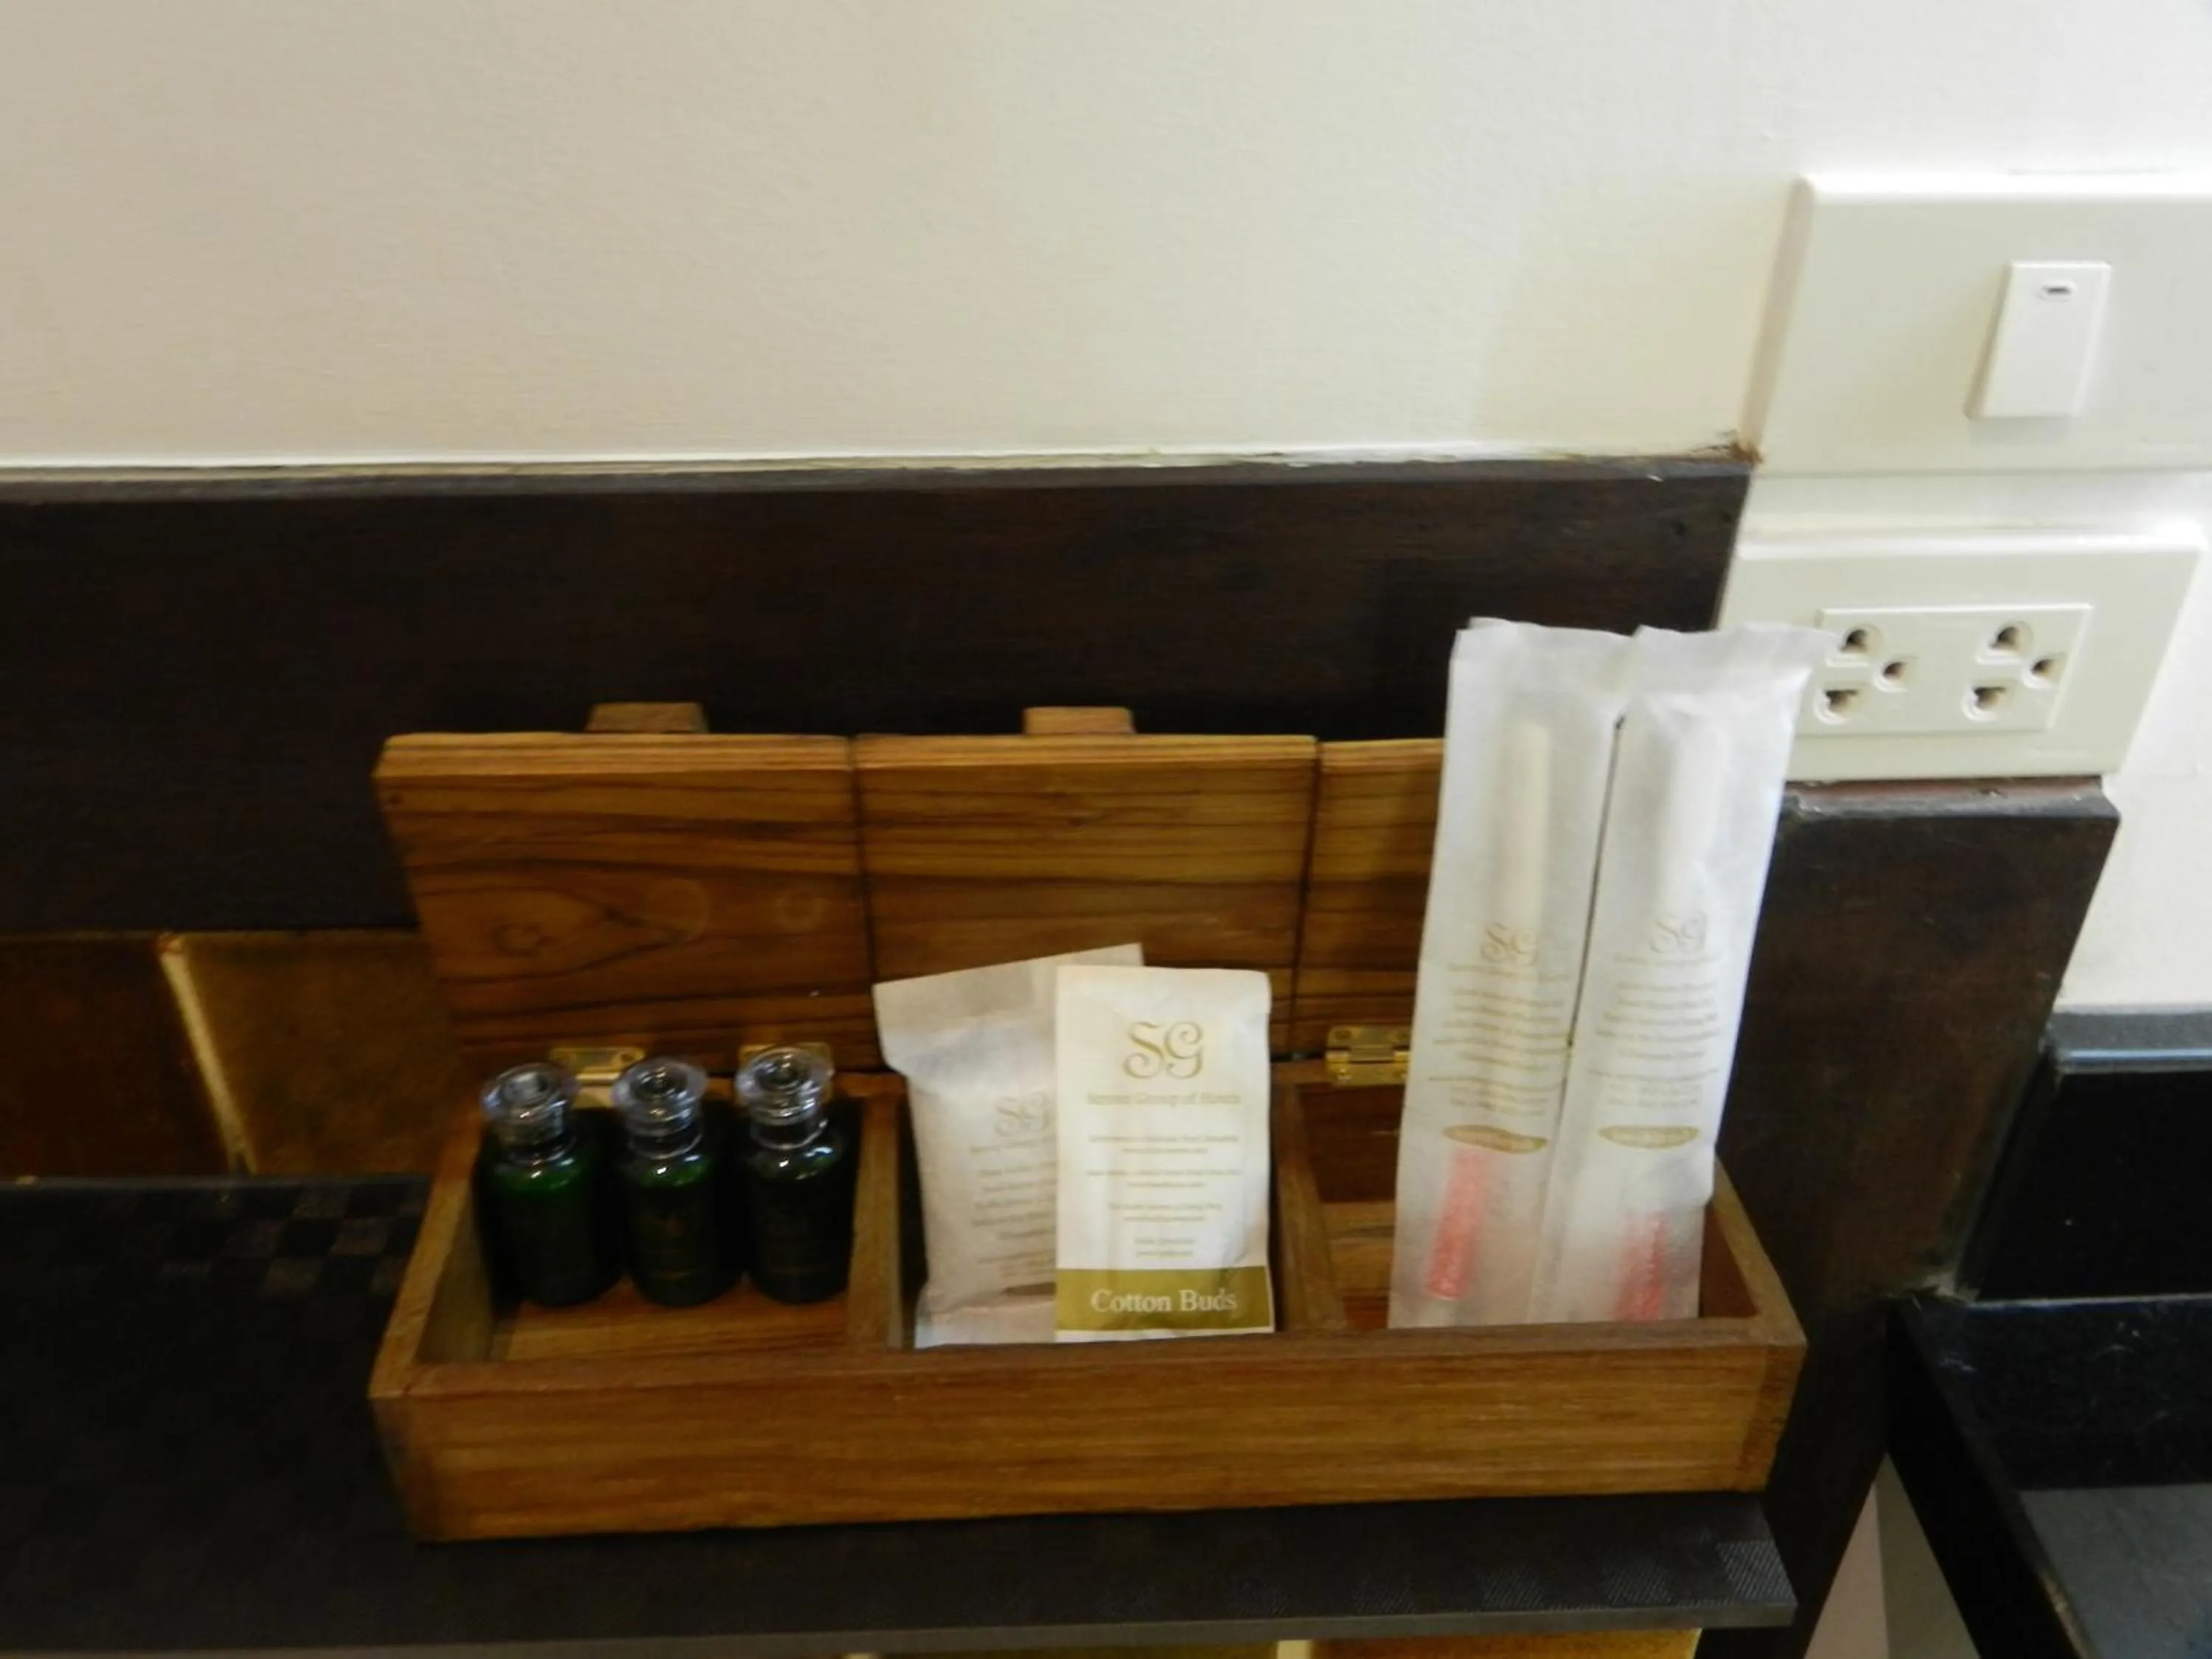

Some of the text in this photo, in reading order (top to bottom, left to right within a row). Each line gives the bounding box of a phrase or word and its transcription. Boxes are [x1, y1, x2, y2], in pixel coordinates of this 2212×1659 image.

[1121, 1020, 1204, 1079] SG
[1091, 1287, 1239, 1313] Cotton Buds
